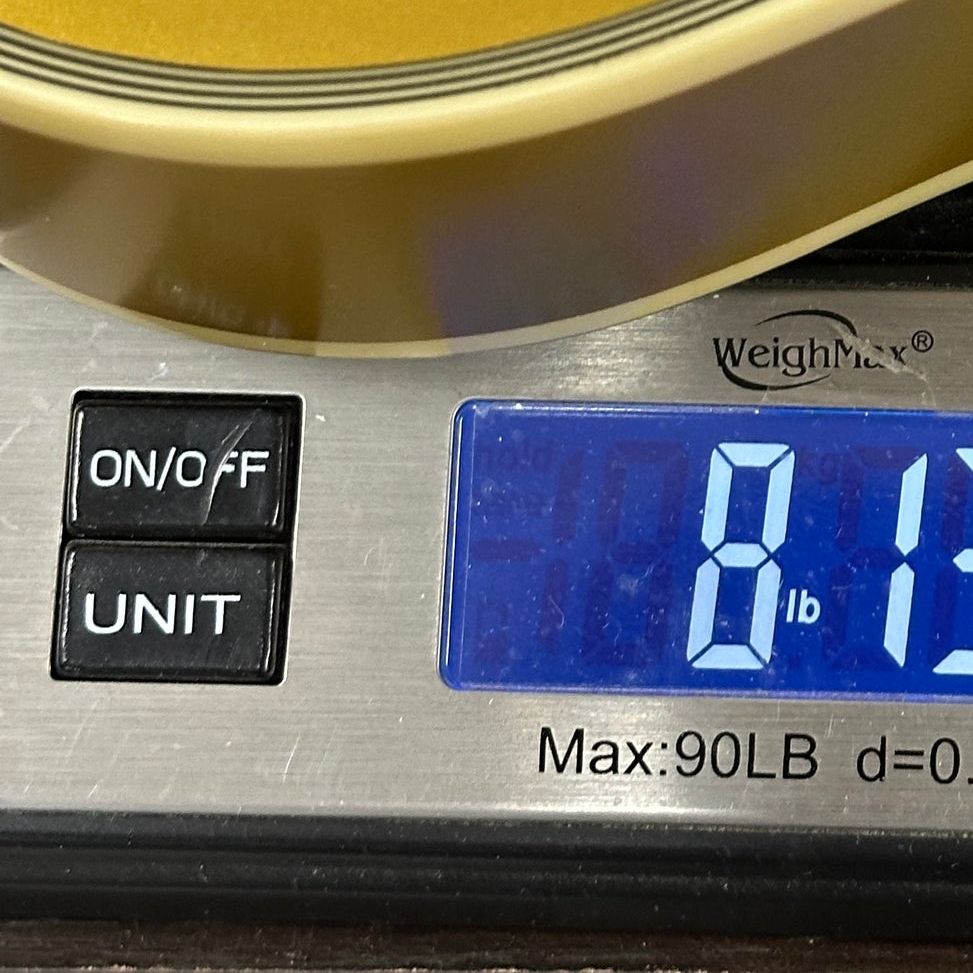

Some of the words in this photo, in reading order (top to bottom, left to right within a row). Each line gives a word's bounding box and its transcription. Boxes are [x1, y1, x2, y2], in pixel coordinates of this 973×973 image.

[686, 442, 796, 670] 8
[787, 589, 821, 624] lb
[84, 592, 241, 635] UNIT
[538, 727, 818, 780] Max:90LB
